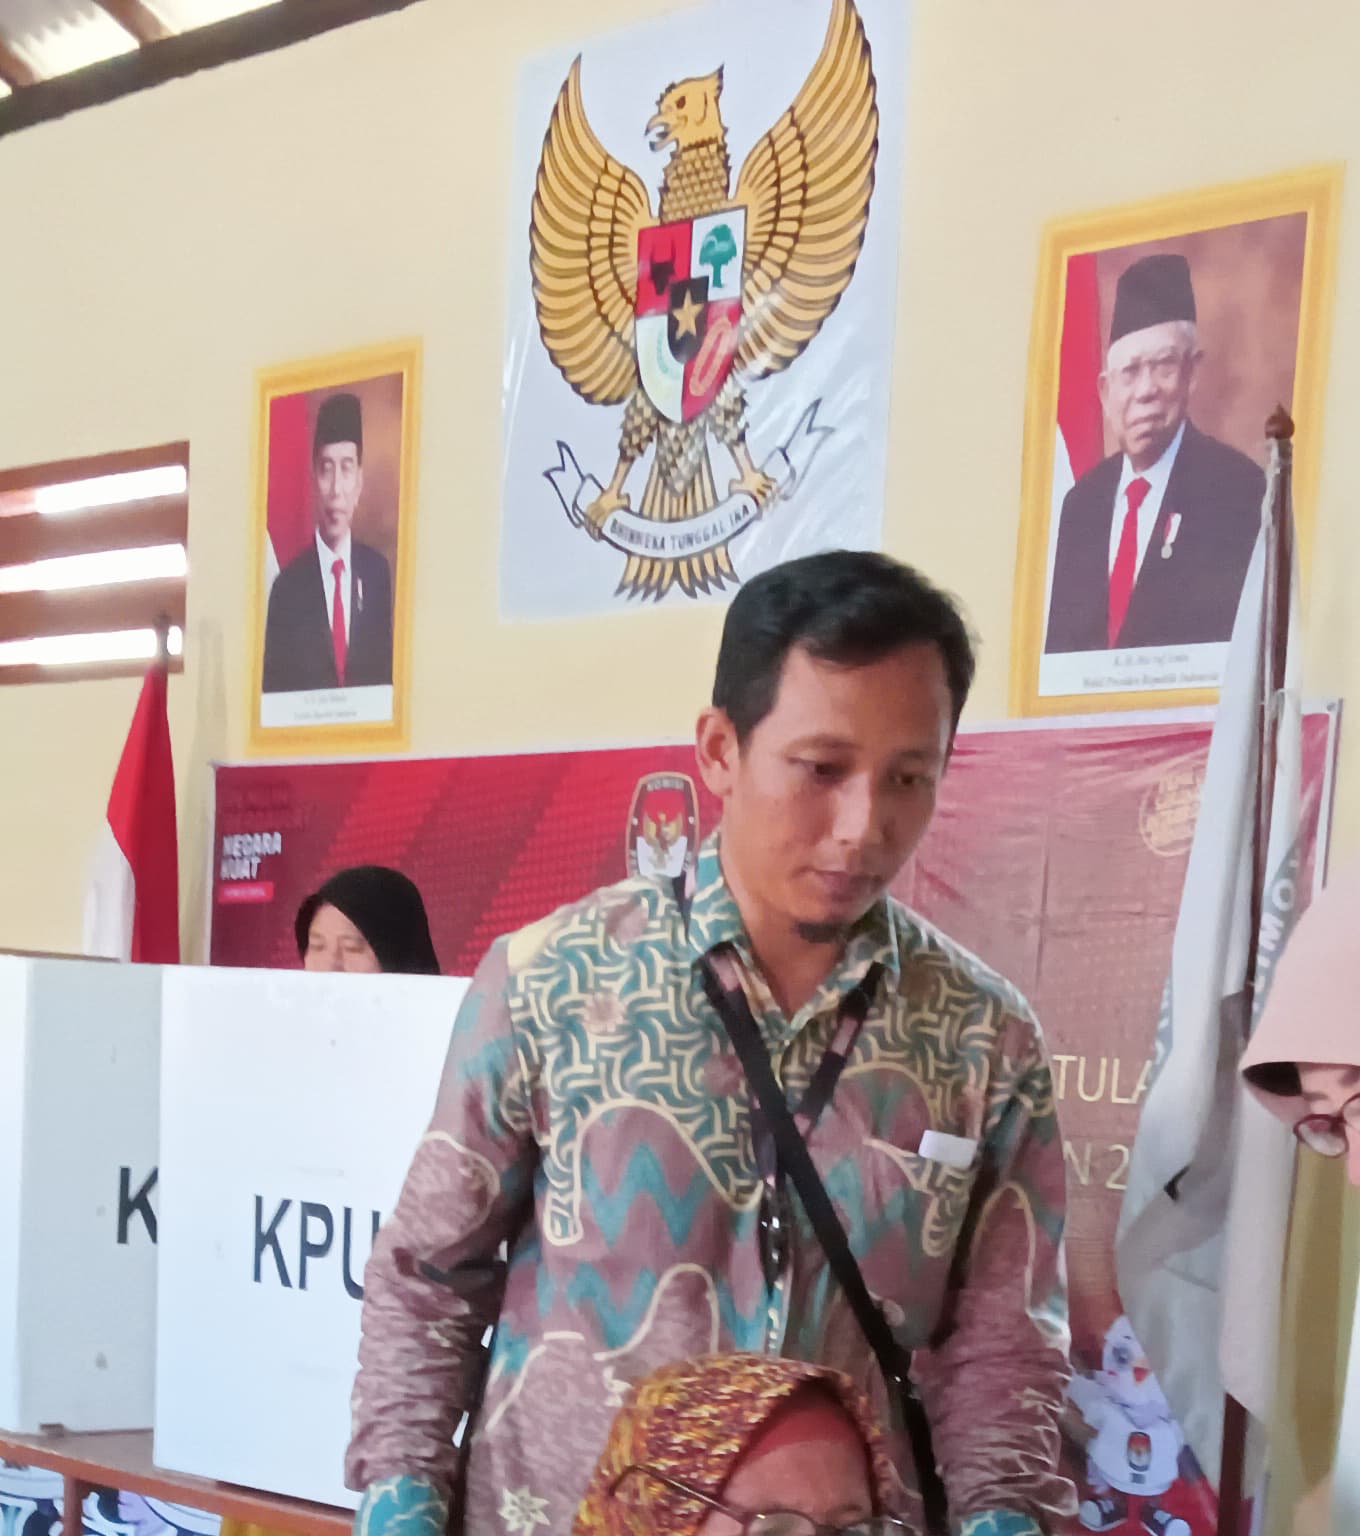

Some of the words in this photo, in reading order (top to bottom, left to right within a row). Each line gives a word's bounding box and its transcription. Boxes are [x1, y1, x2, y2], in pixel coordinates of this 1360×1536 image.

[223, 831, 282, 857] NEGARA
[116, 1166, 158, 1244] K
[253, 1193, 381, 1301] KPU
